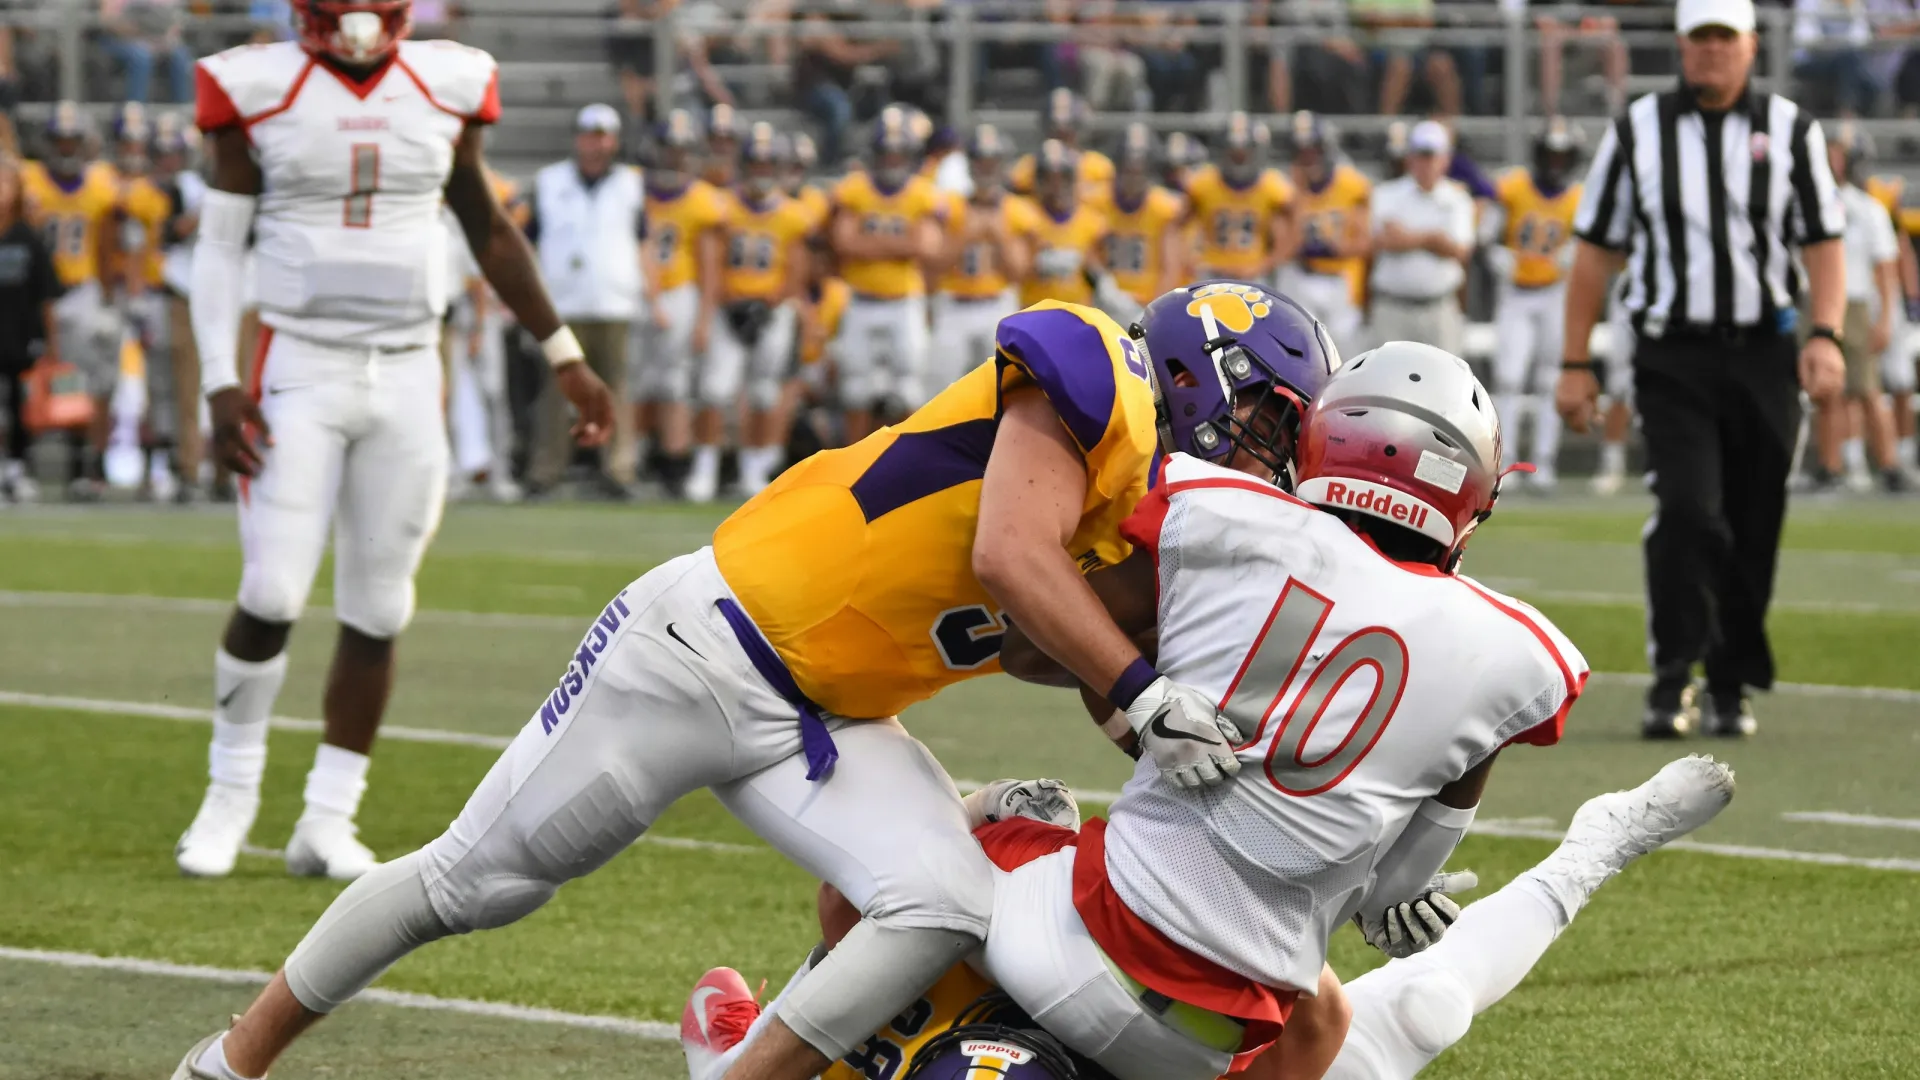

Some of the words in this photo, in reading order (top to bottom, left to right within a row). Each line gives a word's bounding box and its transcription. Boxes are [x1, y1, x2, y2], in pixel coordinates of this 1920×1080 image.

[342, 142, 380, 229] 1
[1325, 481, 1429, 529] Riddell
[540, 589, 631, 736] JACKSON
[1216, 574, 1410, 797] 10
[967, 1044, 1021, 1060] Riddell
